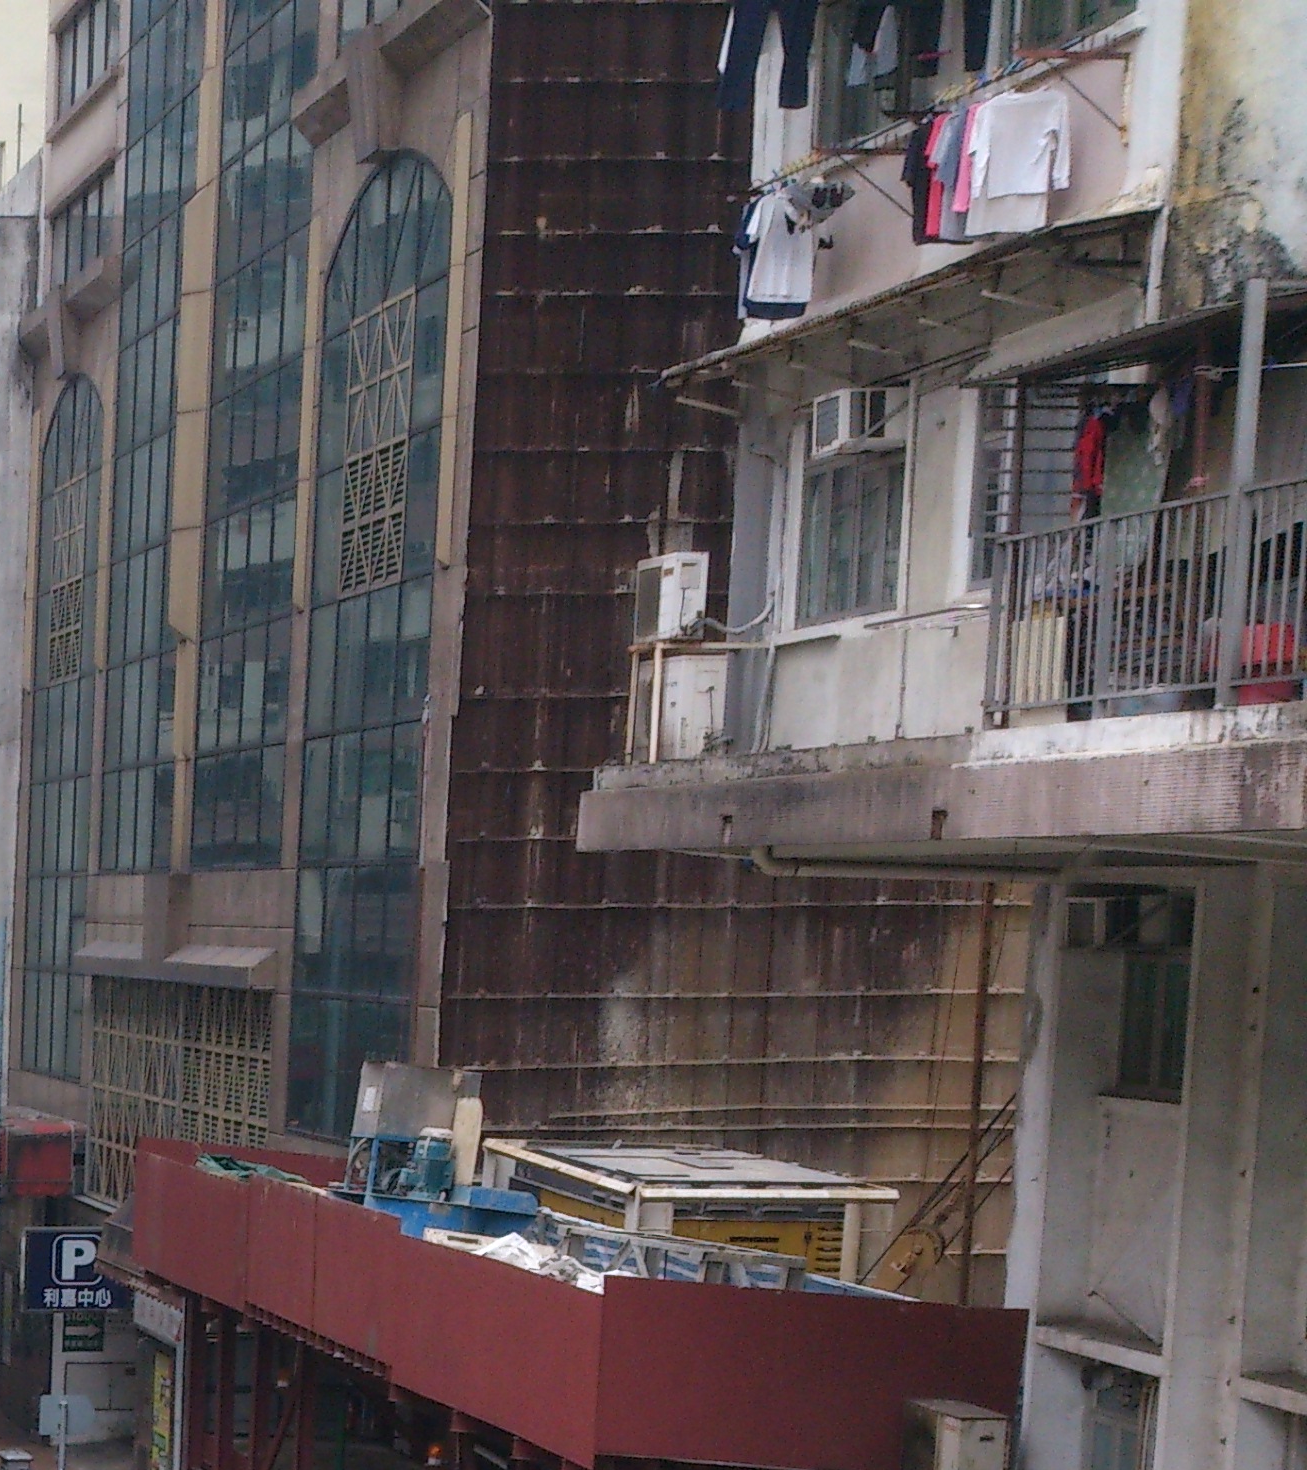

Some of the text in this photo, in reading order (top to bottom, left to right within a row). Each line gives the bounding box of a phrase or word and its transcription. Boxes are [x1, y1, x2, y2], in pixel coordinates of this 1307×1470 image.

[61, 1239, 97, 1280] P
[43, 1288, 113, 1309] 利嘉中心
